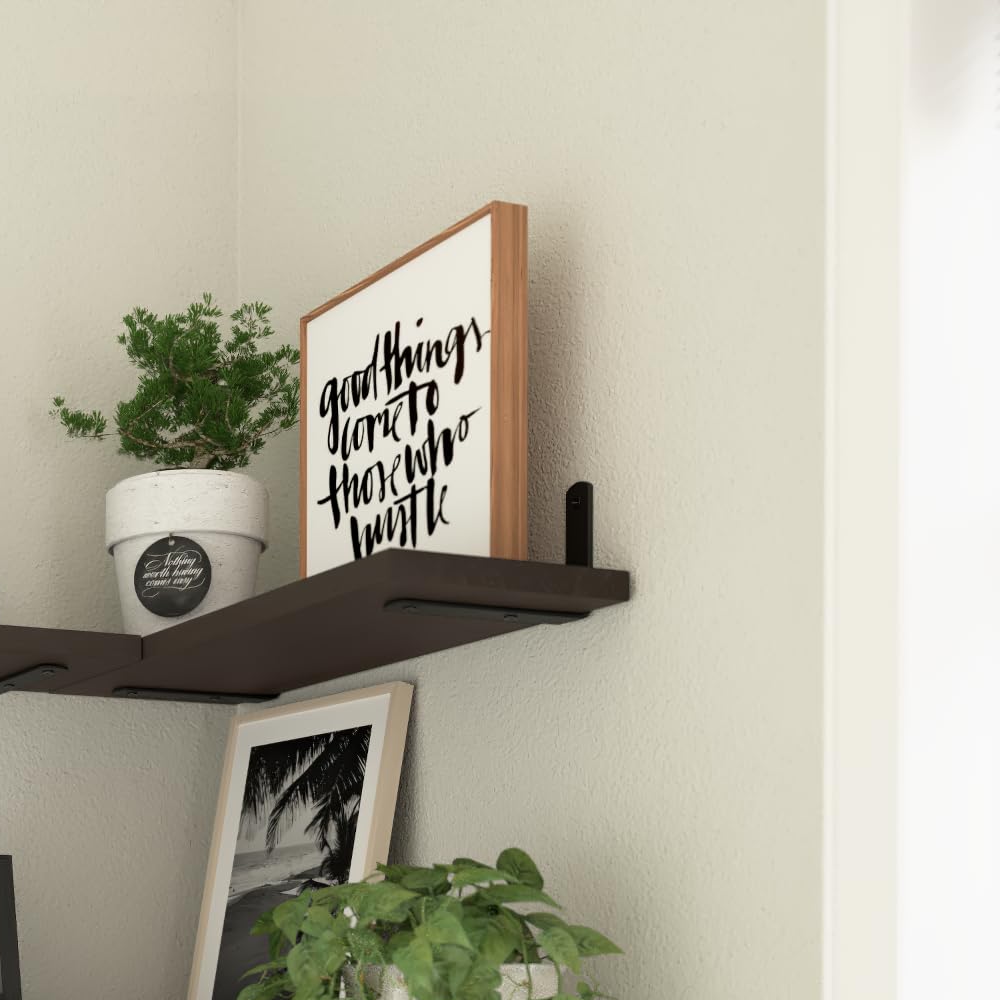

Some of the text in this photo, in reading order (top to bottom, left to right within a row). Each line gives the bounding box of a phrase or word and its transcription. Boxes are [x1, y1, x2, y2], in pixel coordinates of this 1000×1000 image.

[320, 317, 491, 455] good things
[342, 401, 402, 461] come
[317, 407, 482, 530] those who
[350, 477, 450, 560] hustle
